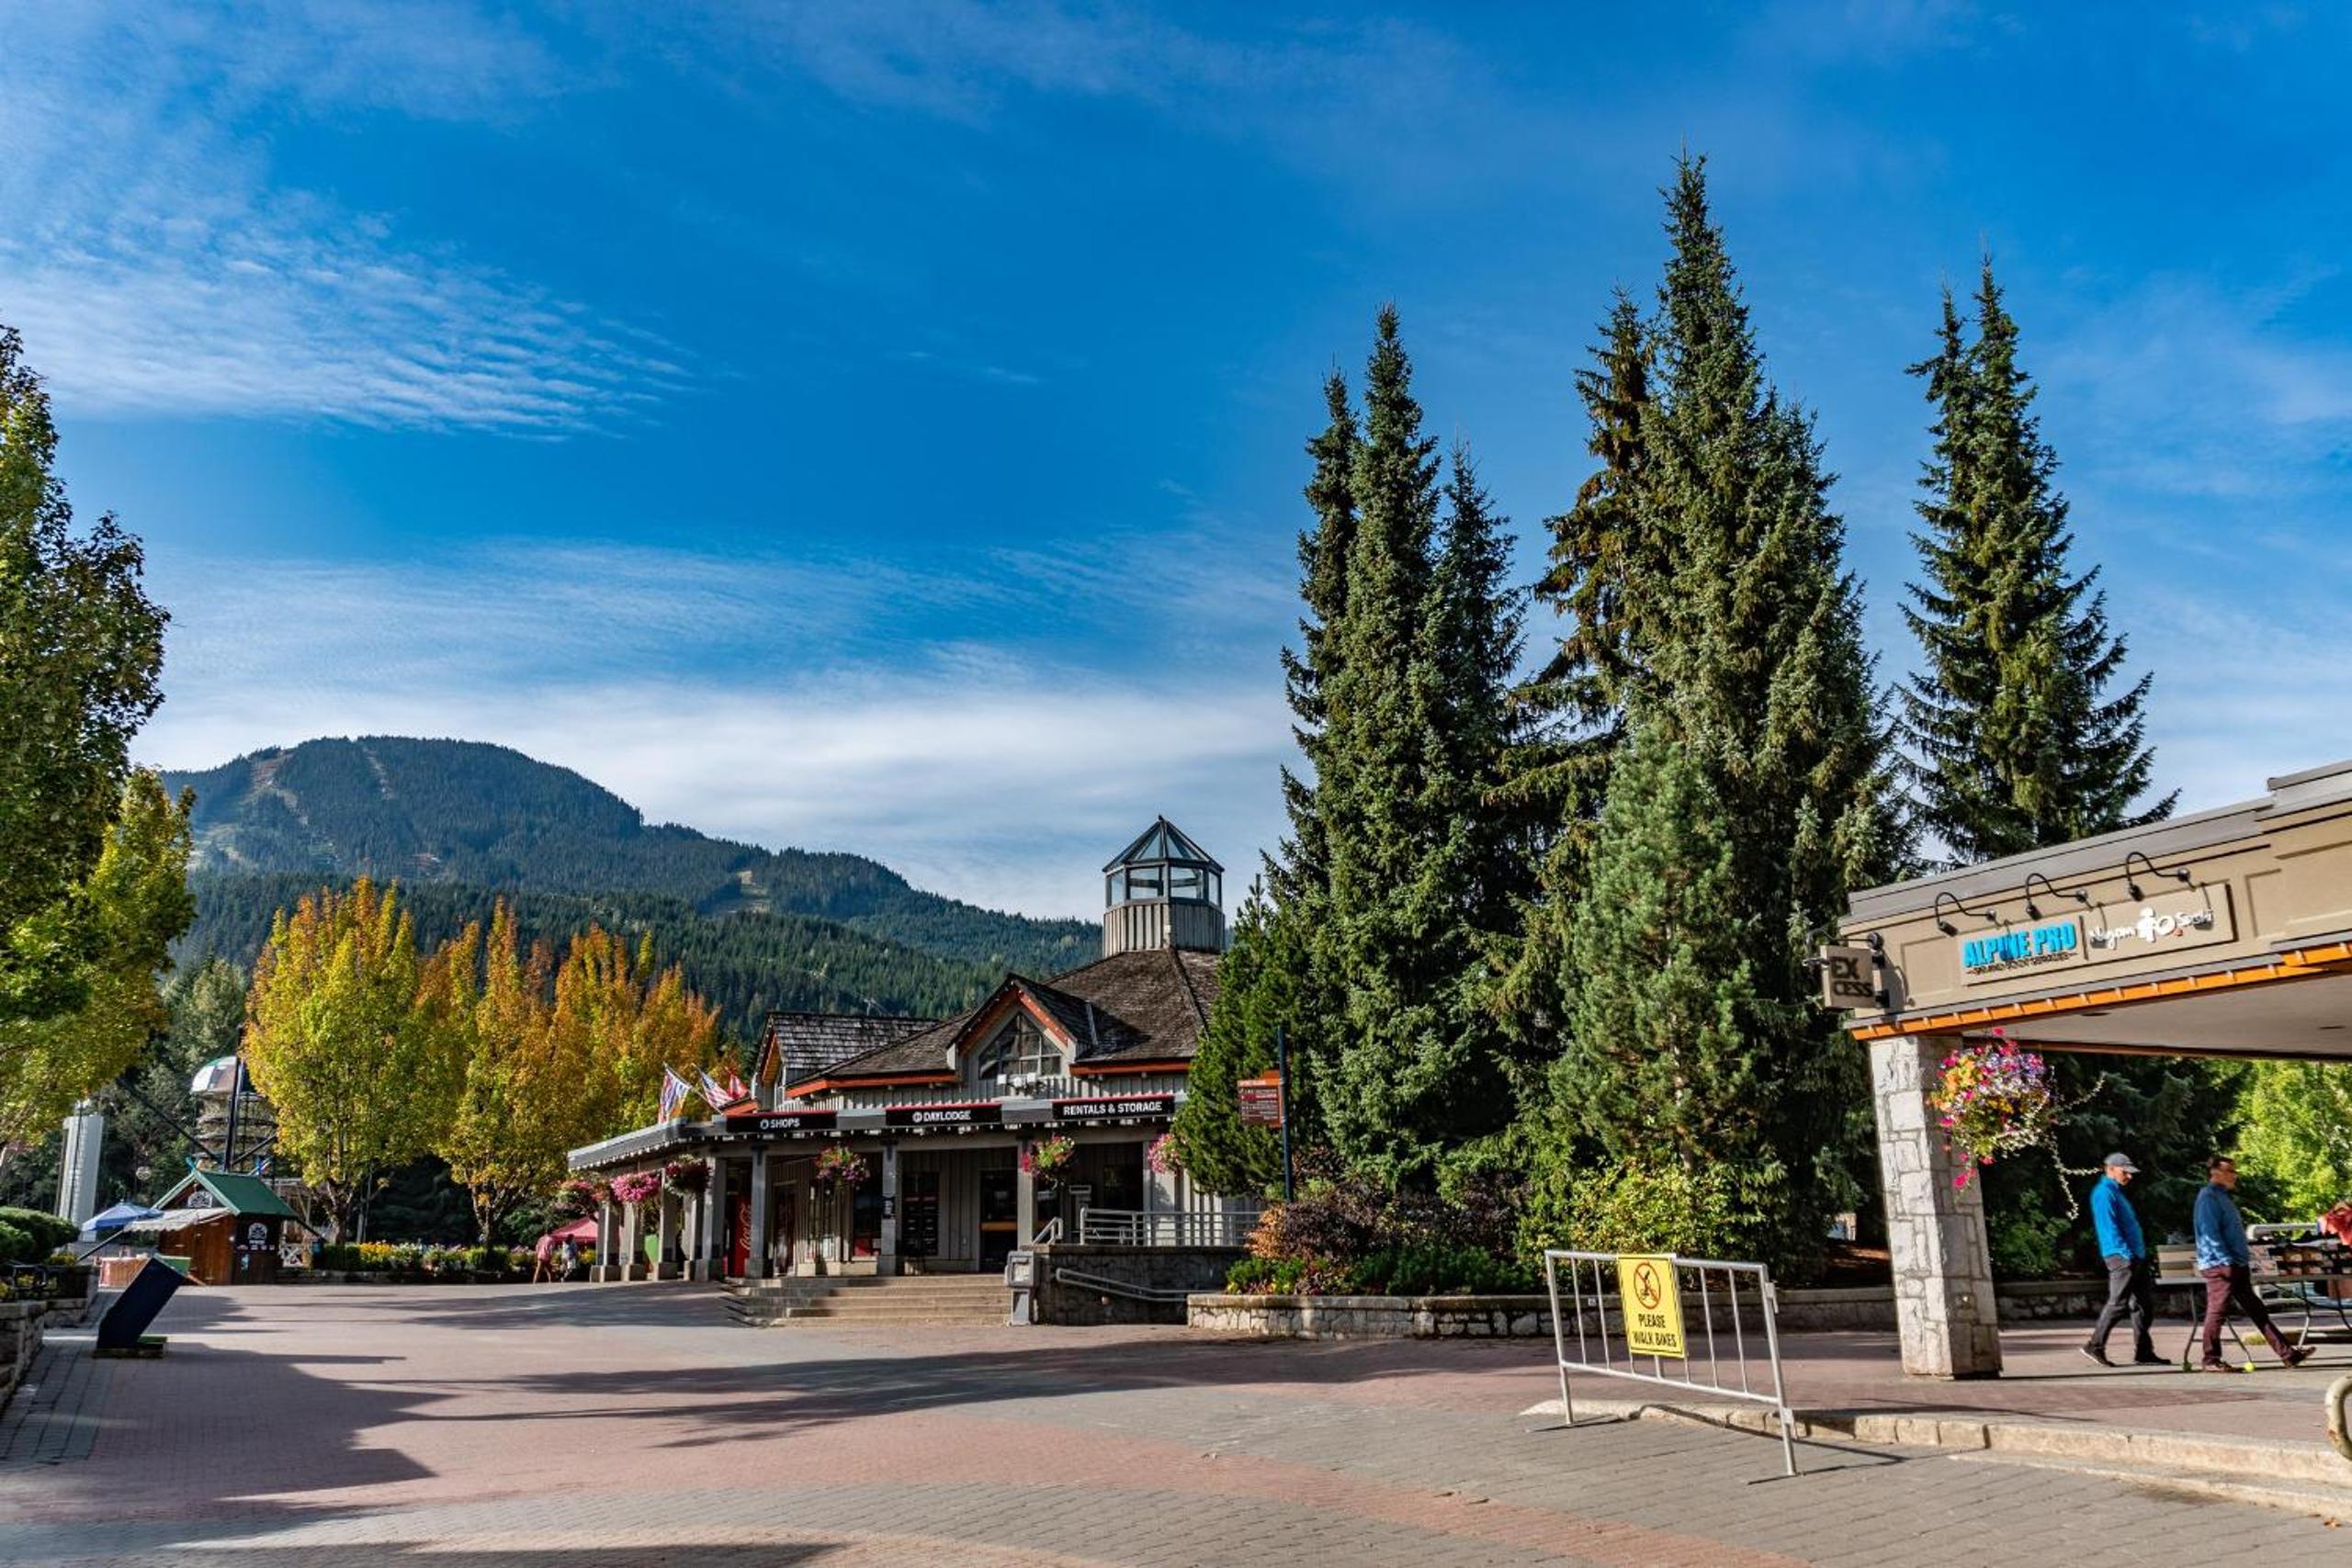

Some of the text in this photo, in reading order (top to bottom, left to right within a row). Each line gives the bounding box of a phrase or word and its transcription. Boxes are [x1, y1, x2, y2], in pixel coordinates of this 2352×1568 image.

[1962, 931, 2031, 968] ALPINE
[2032, 923, 2076, 954] PRO
[1829, 956, 1860, 979] EX
[1834, 981, 1874, 998] CESS
[922, 1110, 971, 1122] DAYLODGE
[1063, 1101, 1162, 1116] RENTALS & STORAGE
[770, 1118, 800, 1129] SHOPS
[1637, 1313, 1666, 1328] PLEASE
[1632, 1330, 1677, 1348] WALK BIKES
